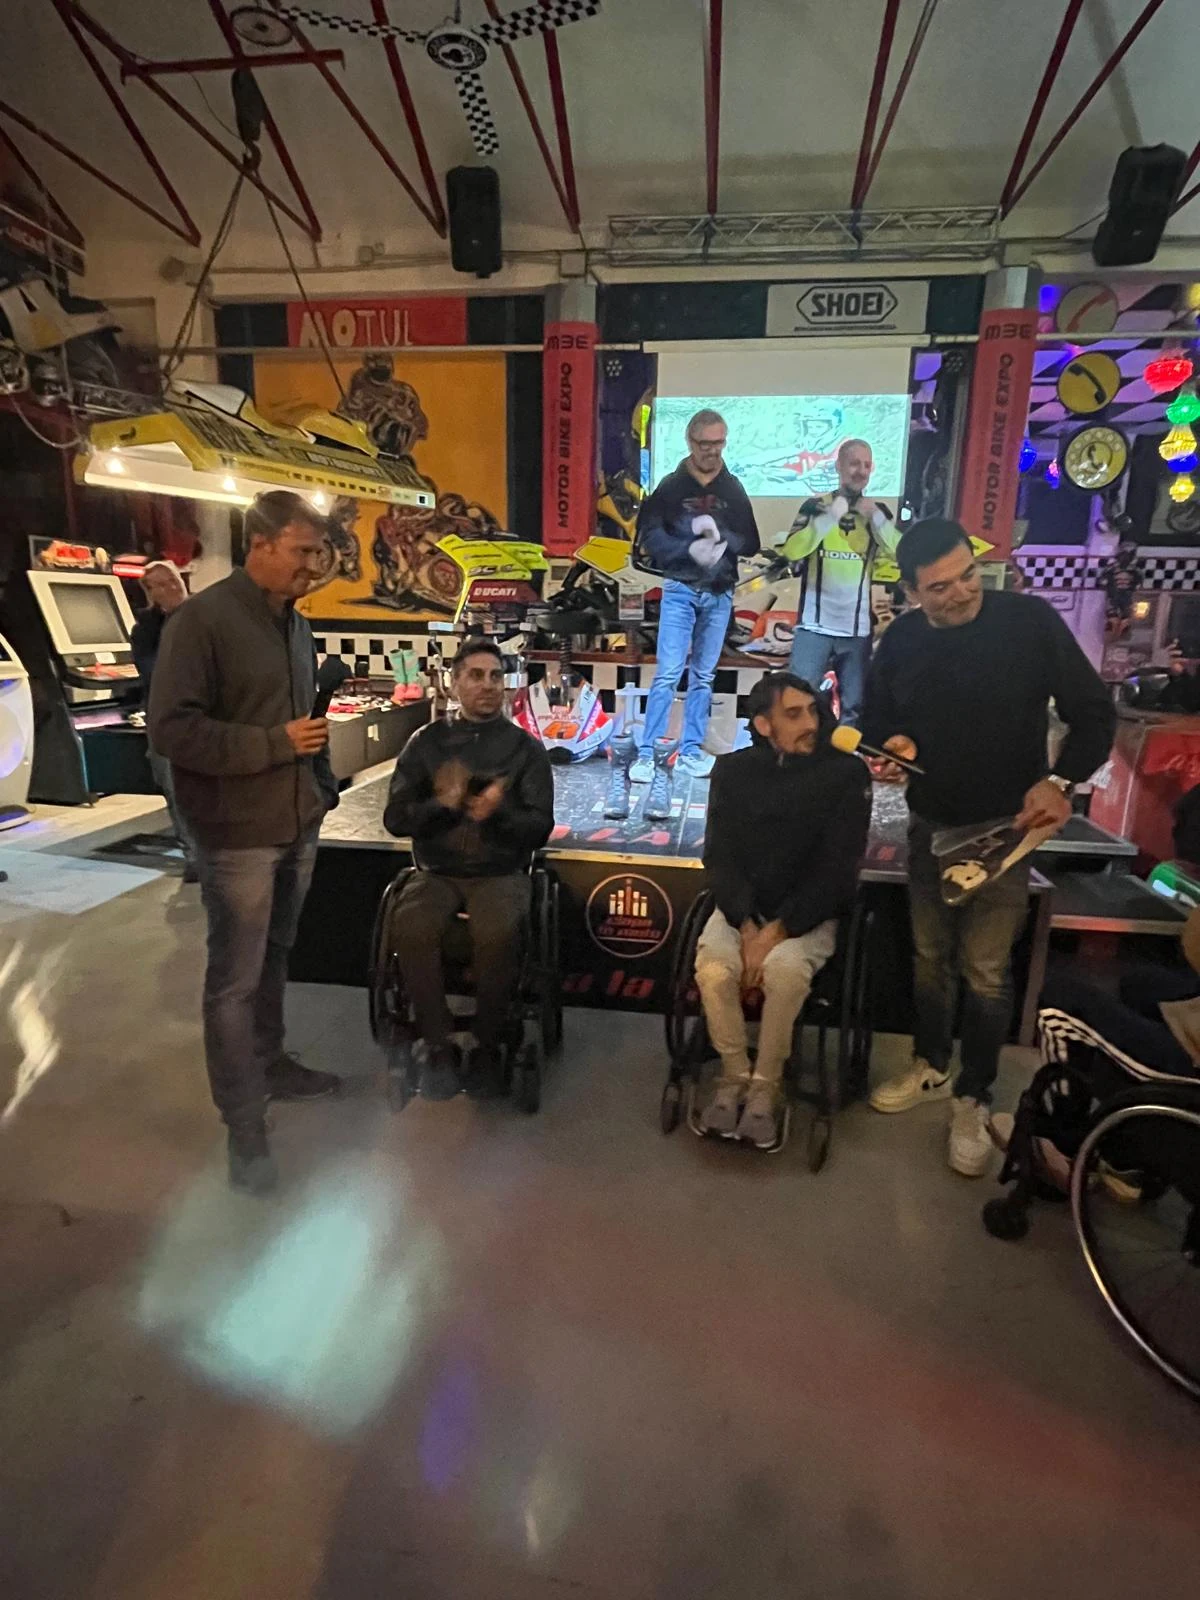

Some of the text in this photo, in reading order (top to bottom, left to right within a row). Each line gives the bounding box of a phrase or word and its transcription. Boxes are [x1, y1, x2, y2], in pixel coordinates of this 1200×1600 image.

[811, 291, 884, 317] SHOEI
[300, 308, 413, 348] MOTUL
[560, 362, 572, 412] EXPO
[559, 417, 572, 459] BIKE
[982, 353, 1015, 531] MOTOR BIKE EXPO
[558, 464, 570, 528] MOTOR
[473, 587, 518, 597] DUCATI
